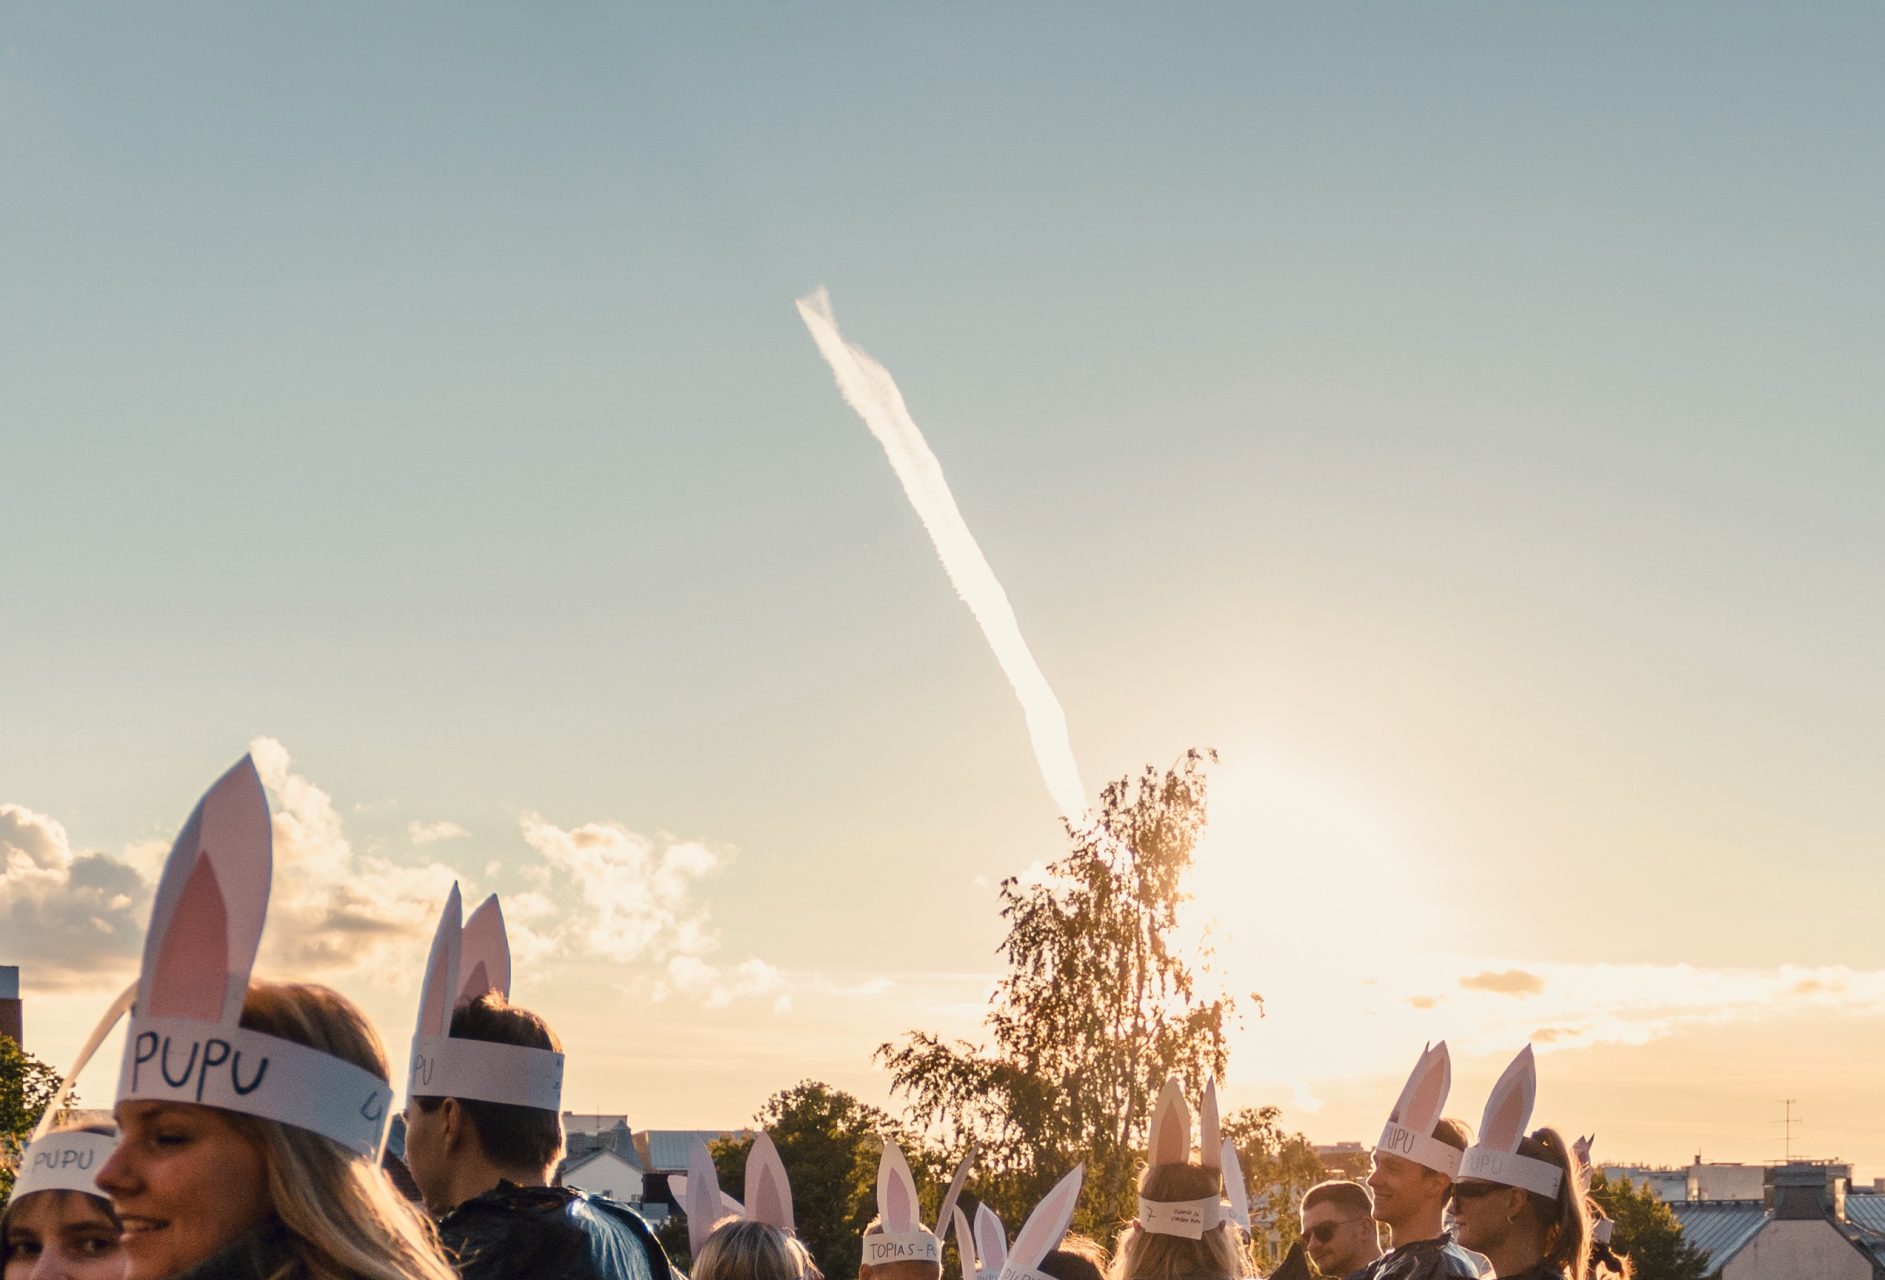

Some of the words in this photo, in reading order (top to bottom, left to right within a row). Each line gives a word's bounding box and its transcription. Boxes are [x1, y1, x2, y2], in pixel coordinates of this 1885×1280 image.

[132, 1030, 269, 1102] PUPU
[1381, 1126, 1415, 1154] PUPU
[34, 1149, 94, 1170] PUPU
